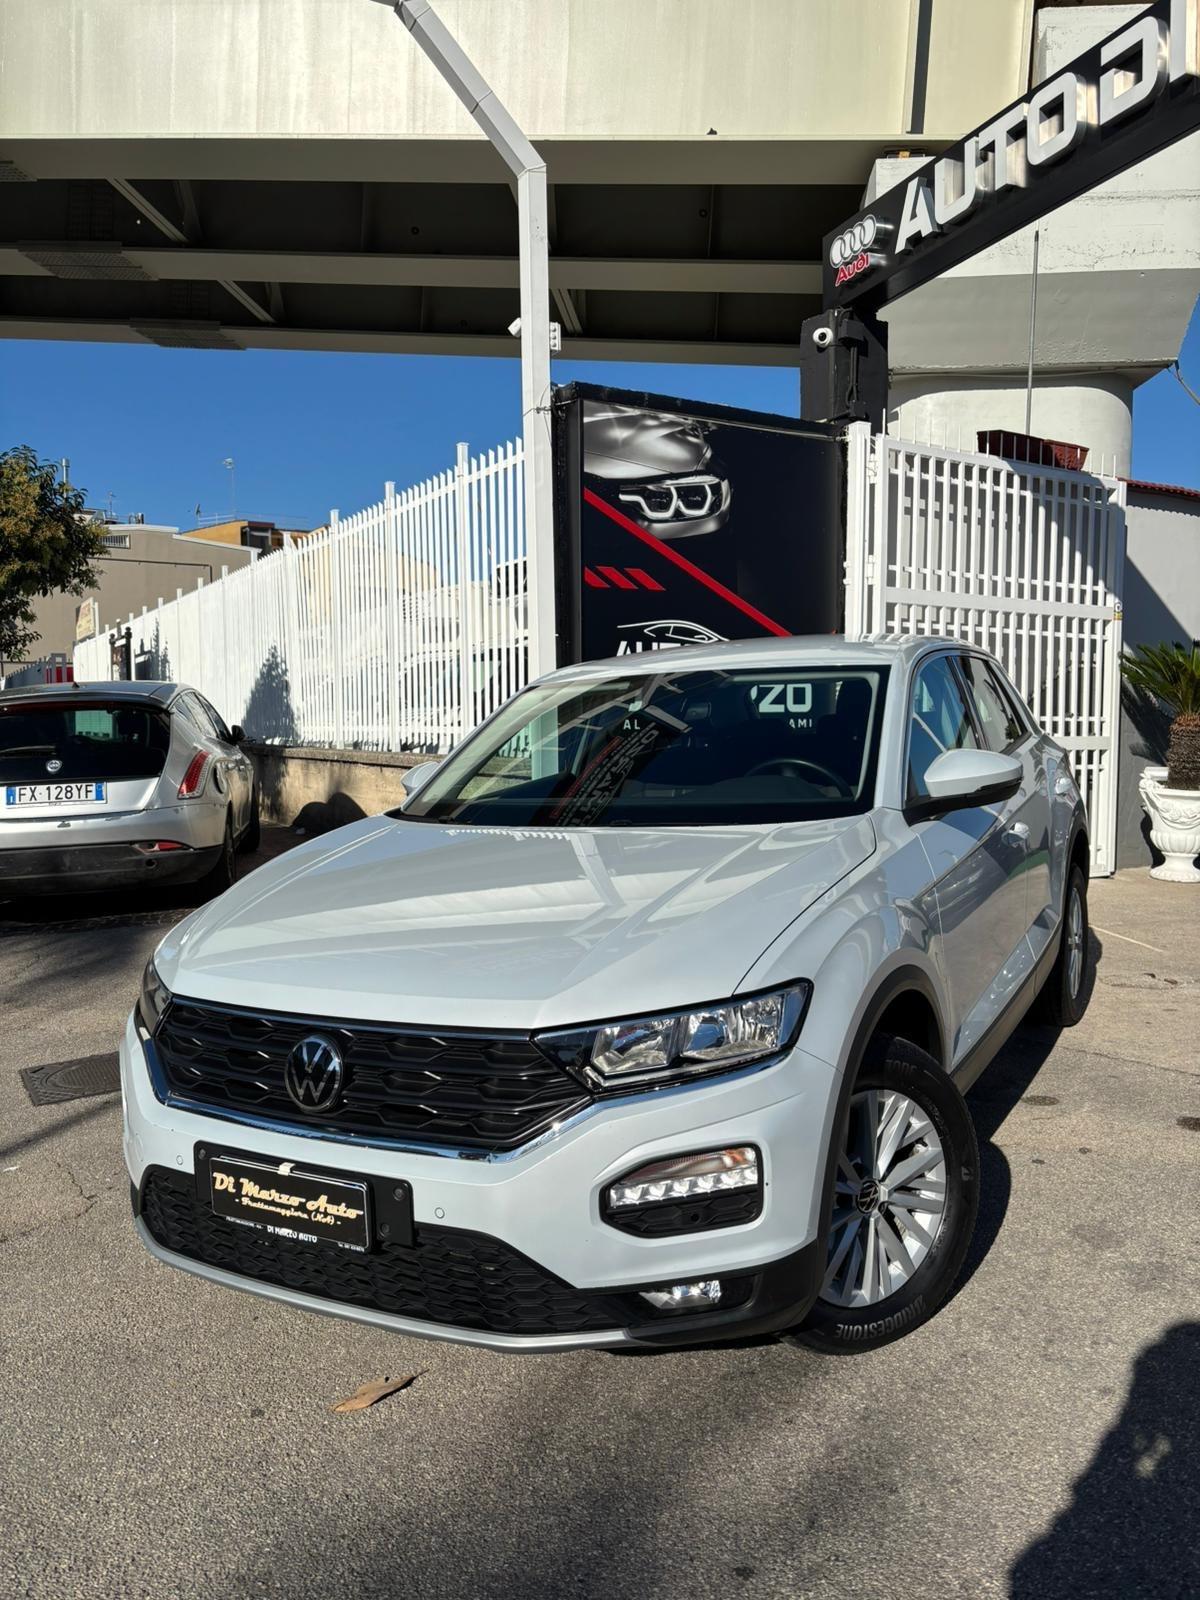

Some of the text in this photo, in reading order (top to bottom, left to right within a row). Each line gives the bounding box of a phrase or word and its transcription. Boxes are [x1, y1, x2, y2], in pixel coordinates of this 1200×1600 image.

[895, 72, 1079, 254] AUTO
[835, 252, 869, 287] Audi
[18, 784, 93, 803] FX 128YF
[212, 1172, 364, 1219] Di Marzo Auto
[298, 1232, 318, 1244] AUTO
